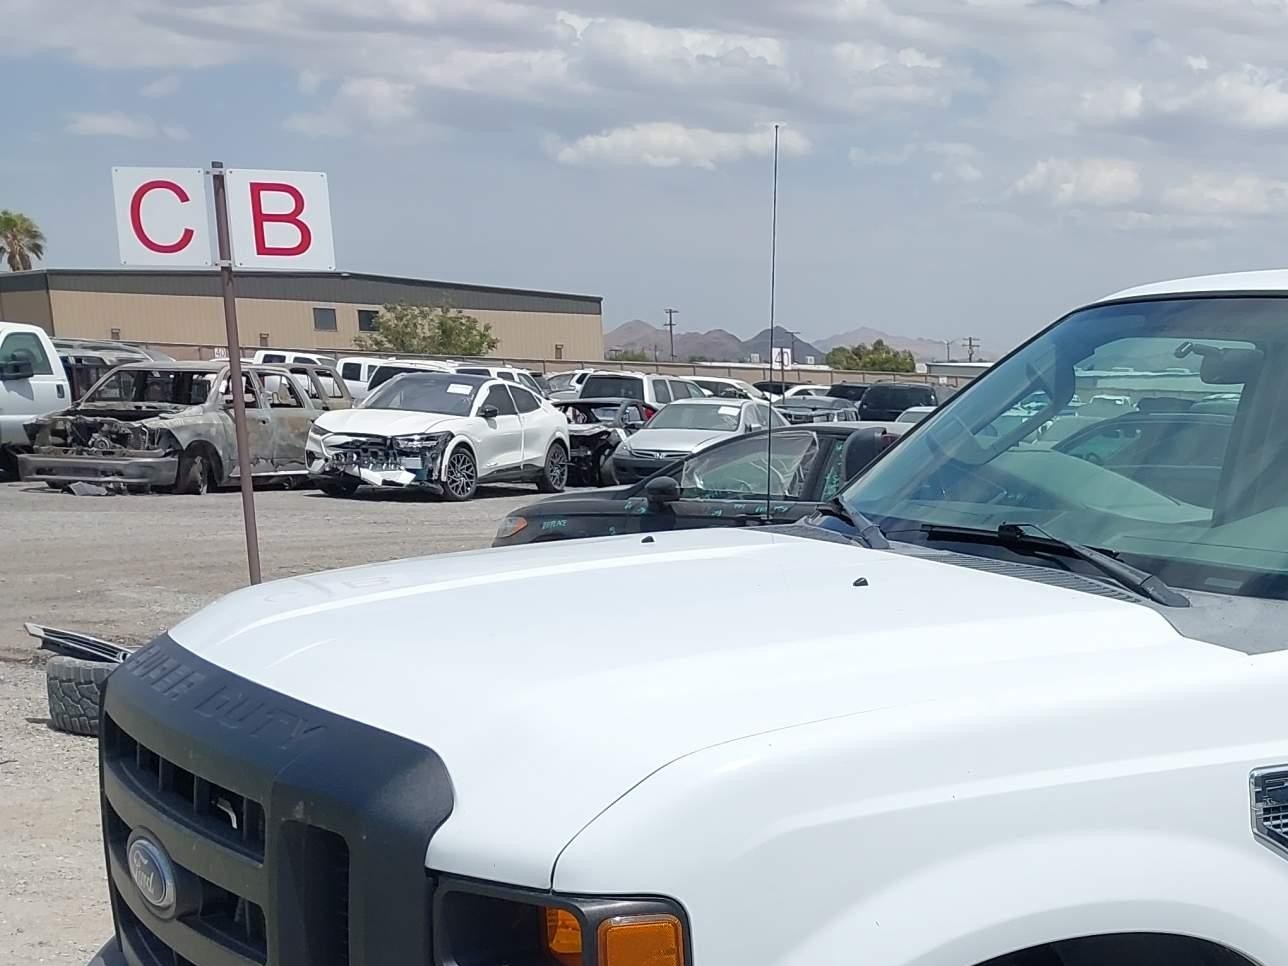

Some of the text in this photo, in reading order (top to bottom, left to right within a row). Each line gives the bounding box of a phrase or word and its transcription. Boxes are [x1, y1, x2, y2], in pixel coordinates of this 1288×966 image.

[129, 180, 195, 254] C
[249, 181, 312, 256] B
[193, 685, 328, 751] DUTY
